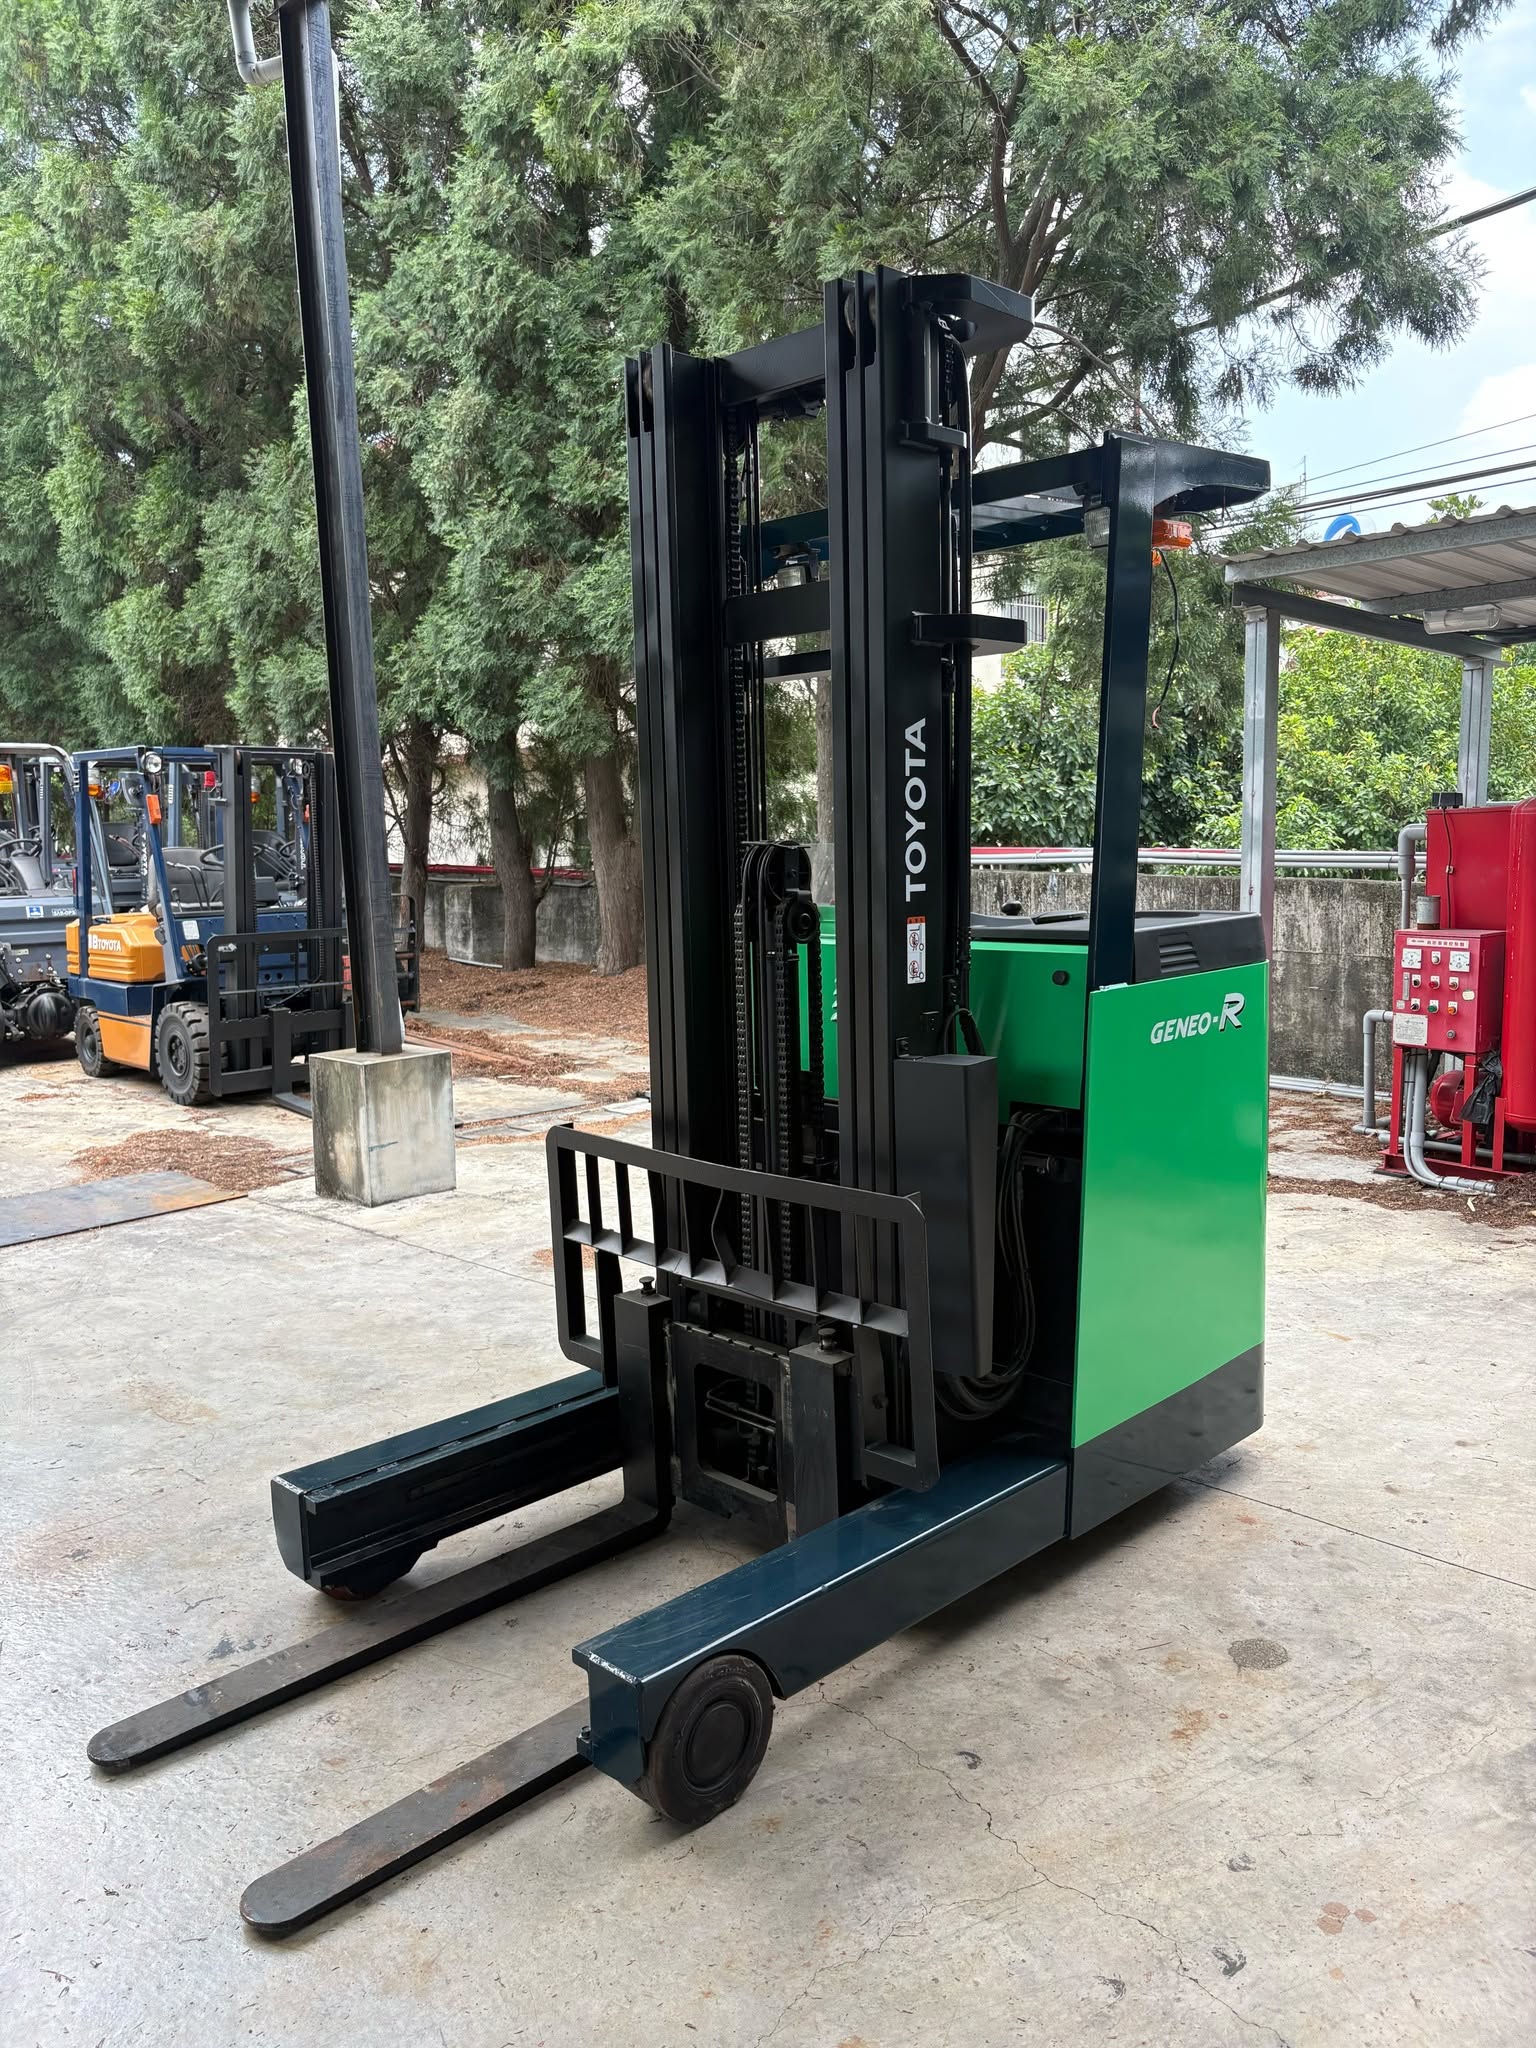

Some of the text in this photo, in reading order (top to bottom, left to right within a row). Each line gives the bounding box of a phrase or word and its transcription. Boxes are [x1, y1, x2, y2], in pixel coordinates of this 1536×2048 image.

[905, 718, 926, 902] TOYOTA
[97, 938, 122, 953] TOYOTA
[1150, 992, 1245, 1044] GENEO-R
